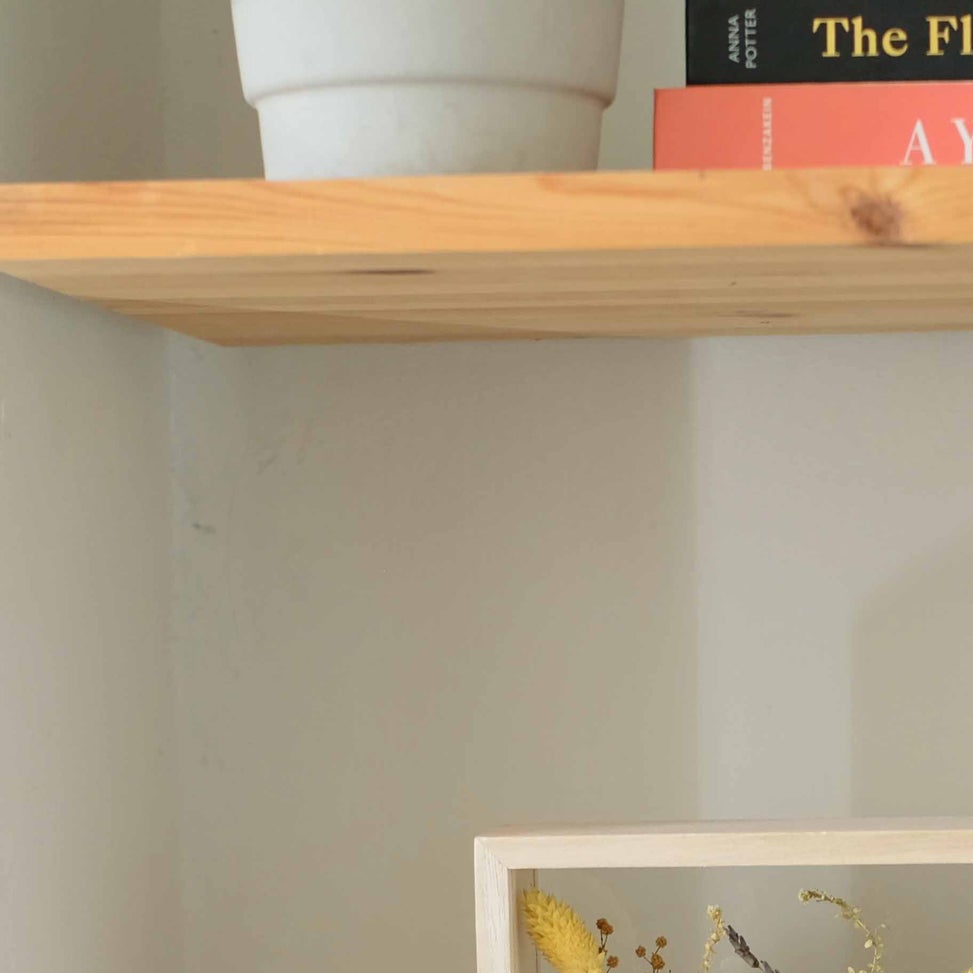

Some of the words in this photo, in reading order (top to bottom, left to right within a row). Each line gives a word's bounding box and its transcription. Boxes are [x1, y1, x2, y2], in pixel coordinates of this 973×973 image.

[728, 14, 740, 63] ANNA
[744, 8, 757, 69] POTTER
[812, 14, 909, 58] The
[902, 117, 937, 166] A
